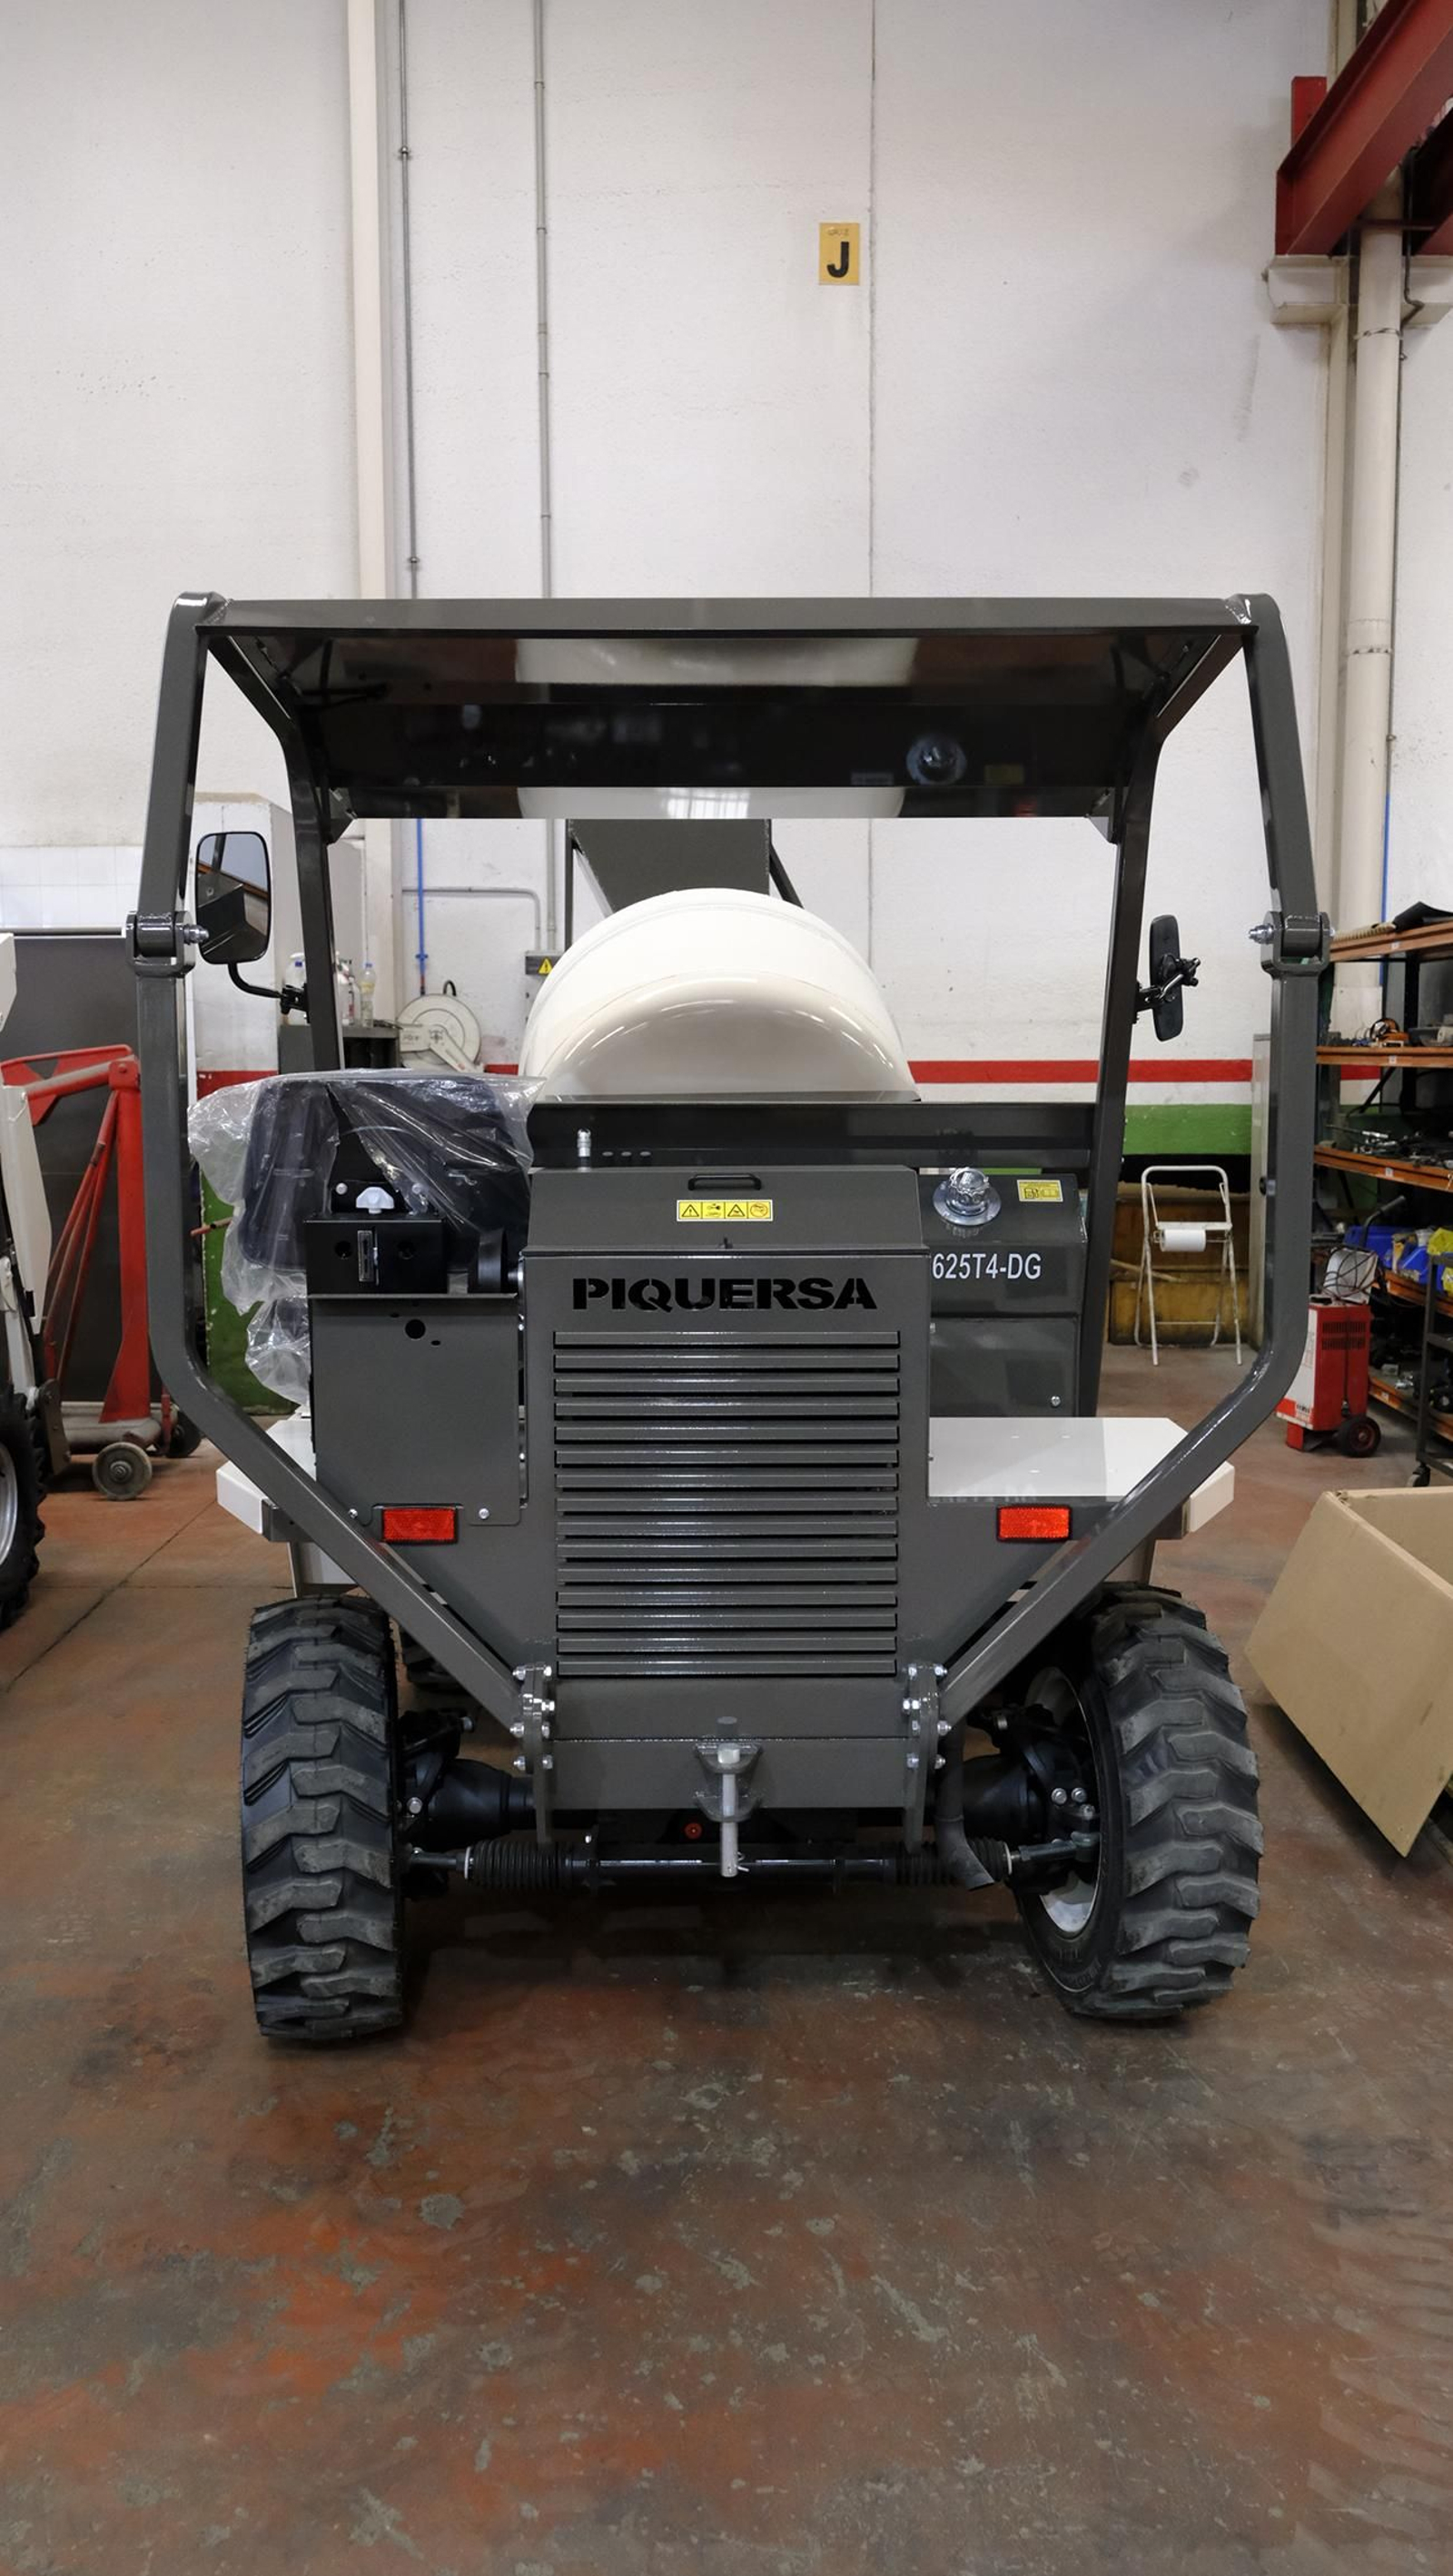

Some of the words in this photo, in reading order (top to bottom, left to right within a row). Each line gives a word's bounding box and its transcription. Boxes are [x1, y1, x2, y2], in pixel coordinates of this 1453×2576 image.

[826, 241, 850, 278] J
[932, 1252, 1042, 1279] 625T4-DG
[572, 1278, 877, 1312] PIQUERSA
